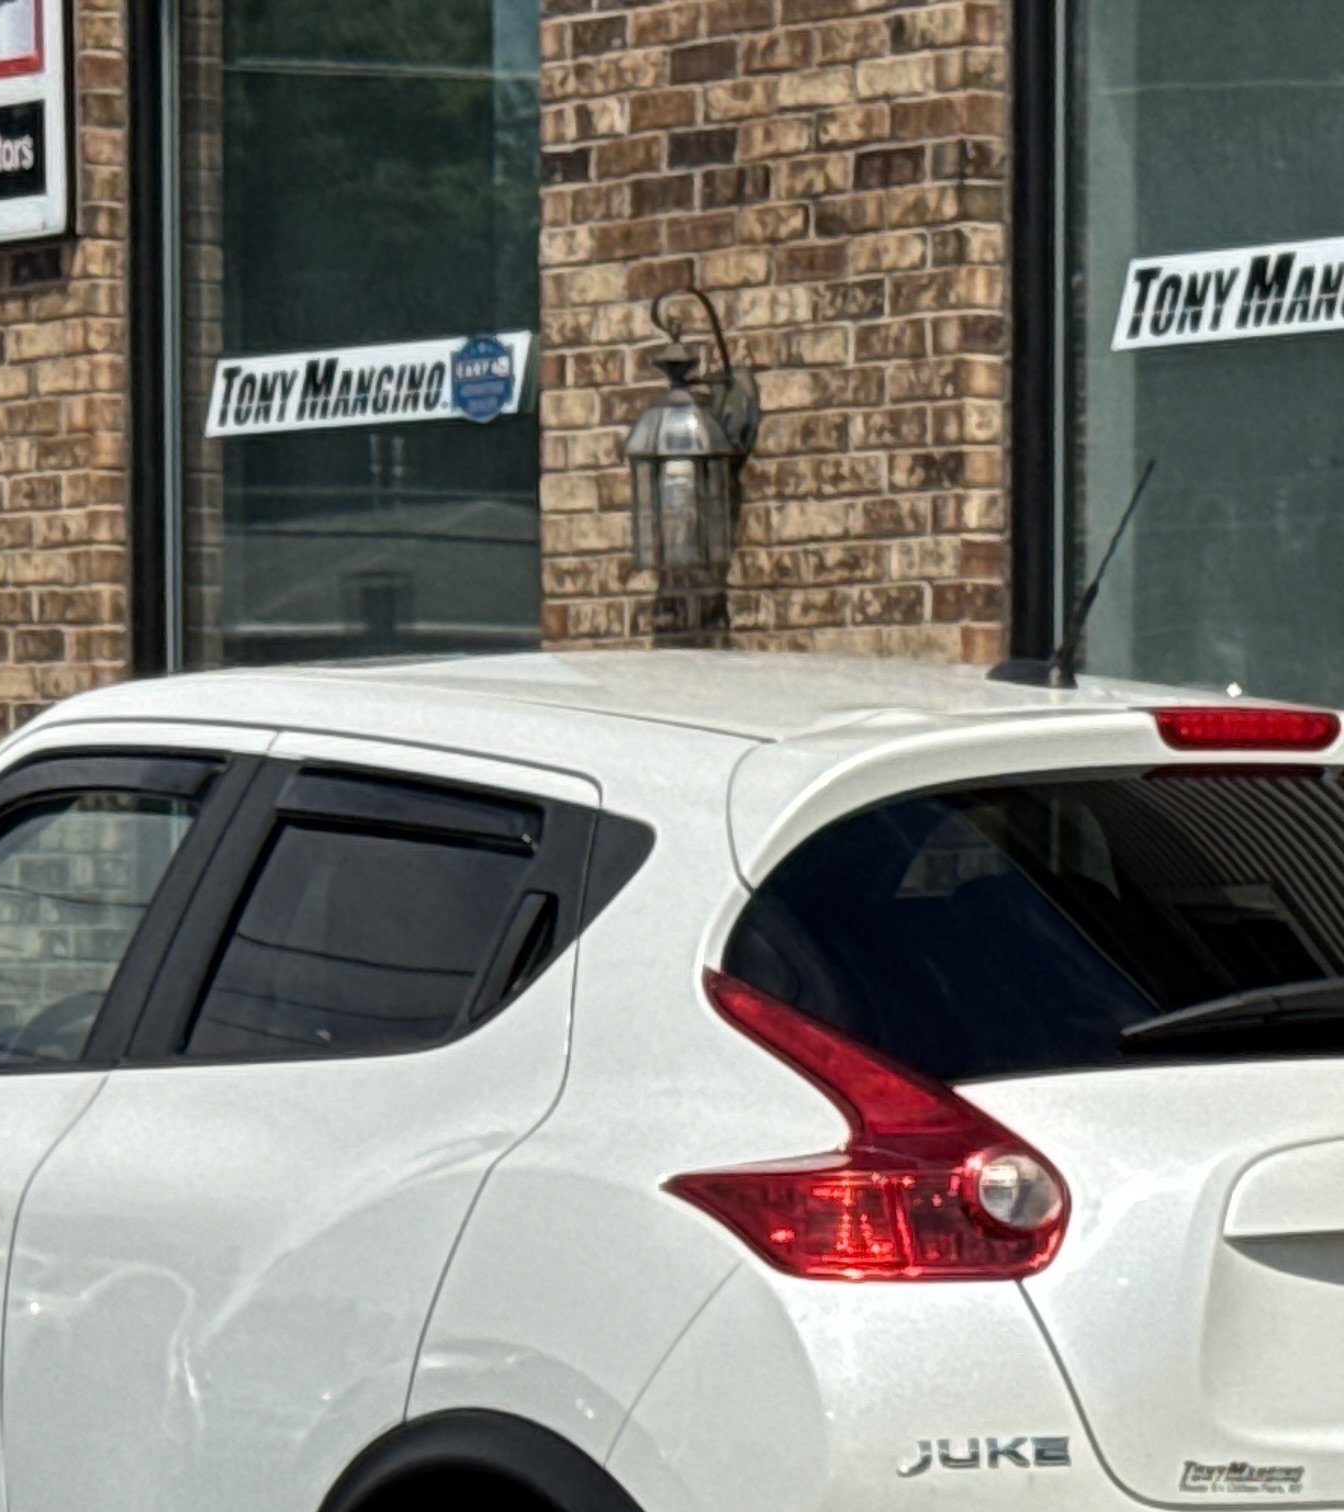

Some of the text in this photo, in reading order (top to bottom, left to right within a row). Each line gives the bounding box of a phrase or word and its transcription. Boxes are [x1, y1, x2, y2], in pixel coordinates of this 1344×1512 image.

[1126, 266, 1240, 340] TONY
[217, 356, 448, 428] TONY MANGINO
[896, 1437, 1072, 1477] JUKE
